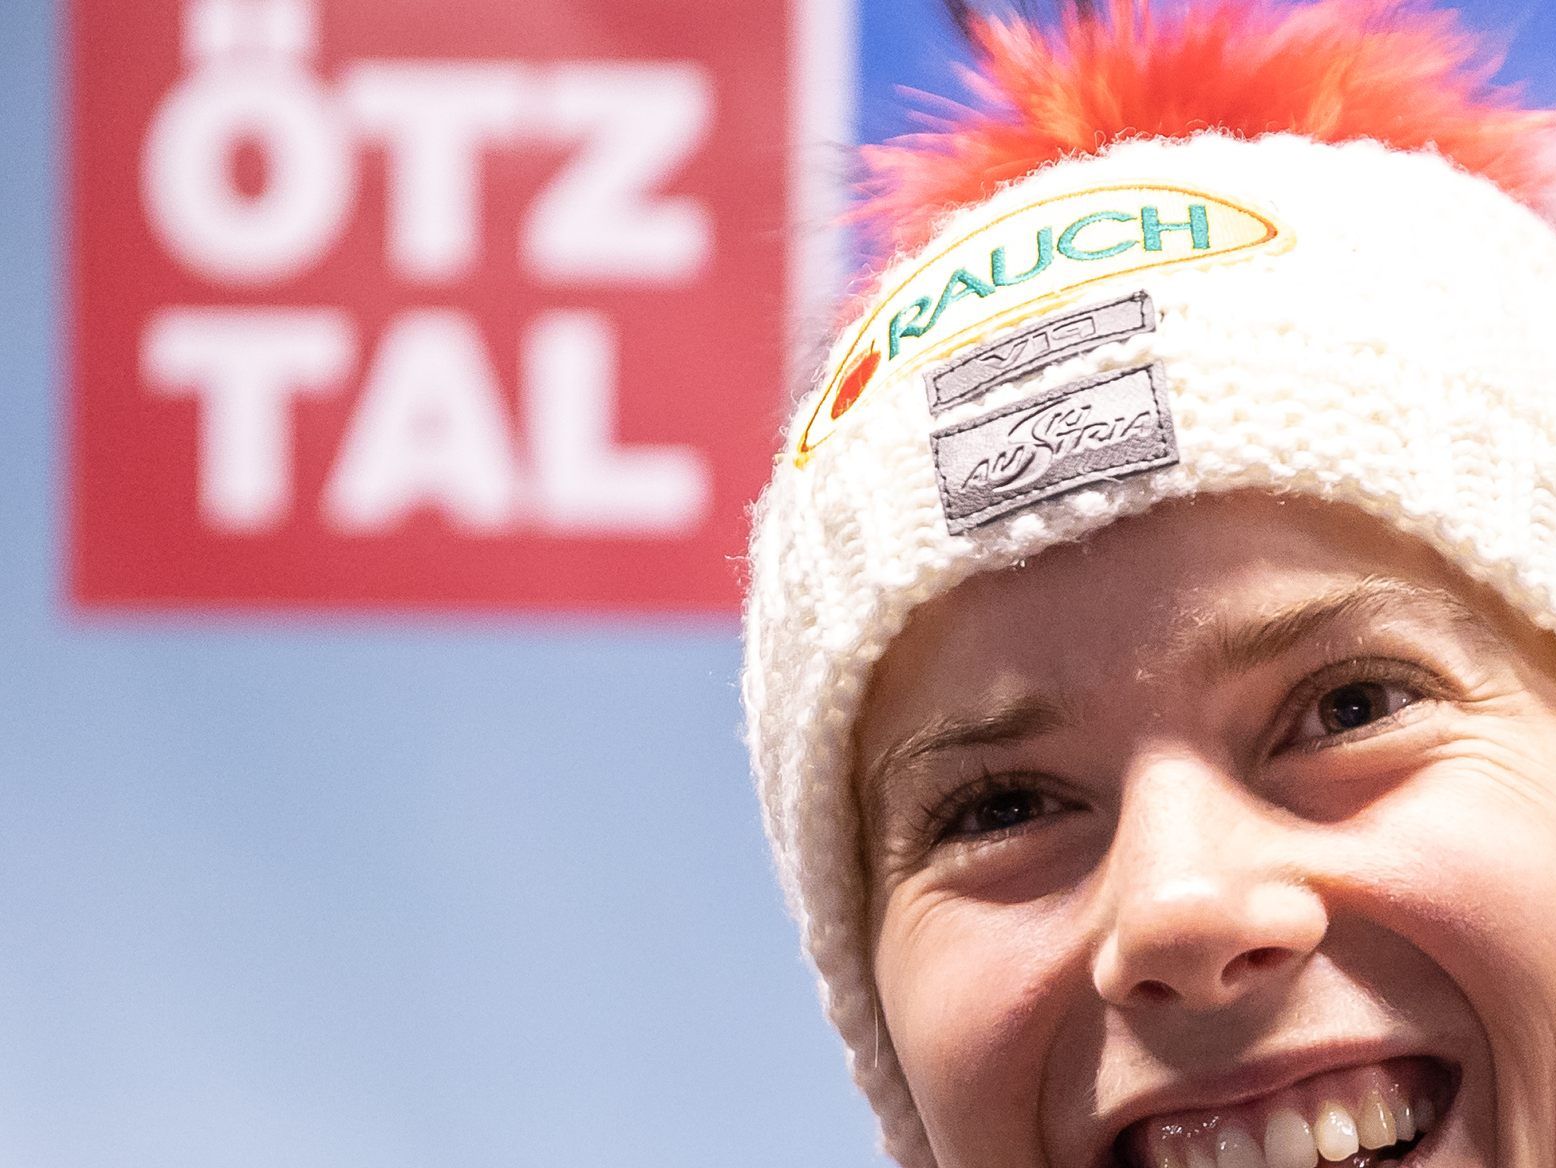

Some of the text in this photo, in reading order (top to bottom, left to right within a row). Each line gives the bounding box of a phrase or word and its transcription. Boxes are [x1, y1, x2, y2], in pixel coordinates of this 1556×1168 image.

[142, 0, 714, 286] ÖTZ
[887, 203, 1212, 361] RAUCH
[140, 305, 712, 536] TAL
